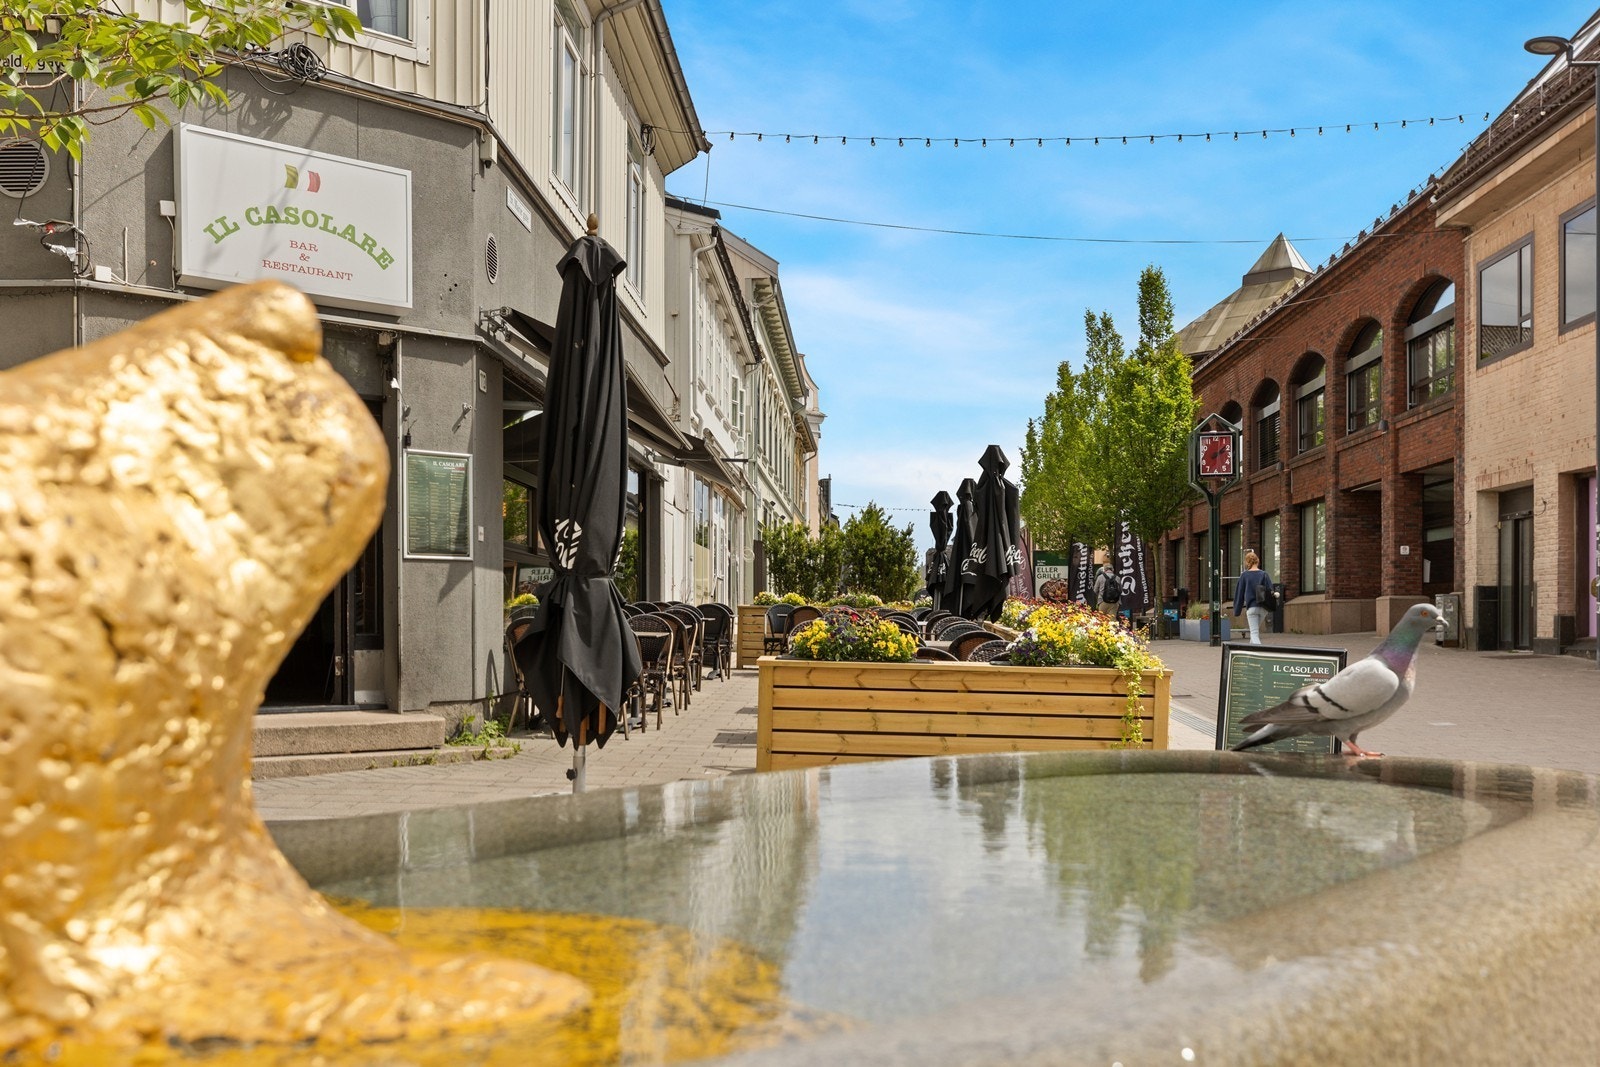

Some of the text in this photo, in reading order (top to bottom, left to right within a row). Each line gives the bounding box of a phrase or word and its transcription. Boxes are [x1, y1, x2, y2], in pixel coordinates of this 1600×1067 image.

[203, 206, 395, 270] IL CASOLARE
[289, 240, 319, 252] BAR
[299, 253, 311, 262] &
[262, 260, 354, 281] RESTAURANT
[1273, 664, 1330, 674] IL CASOLARE
